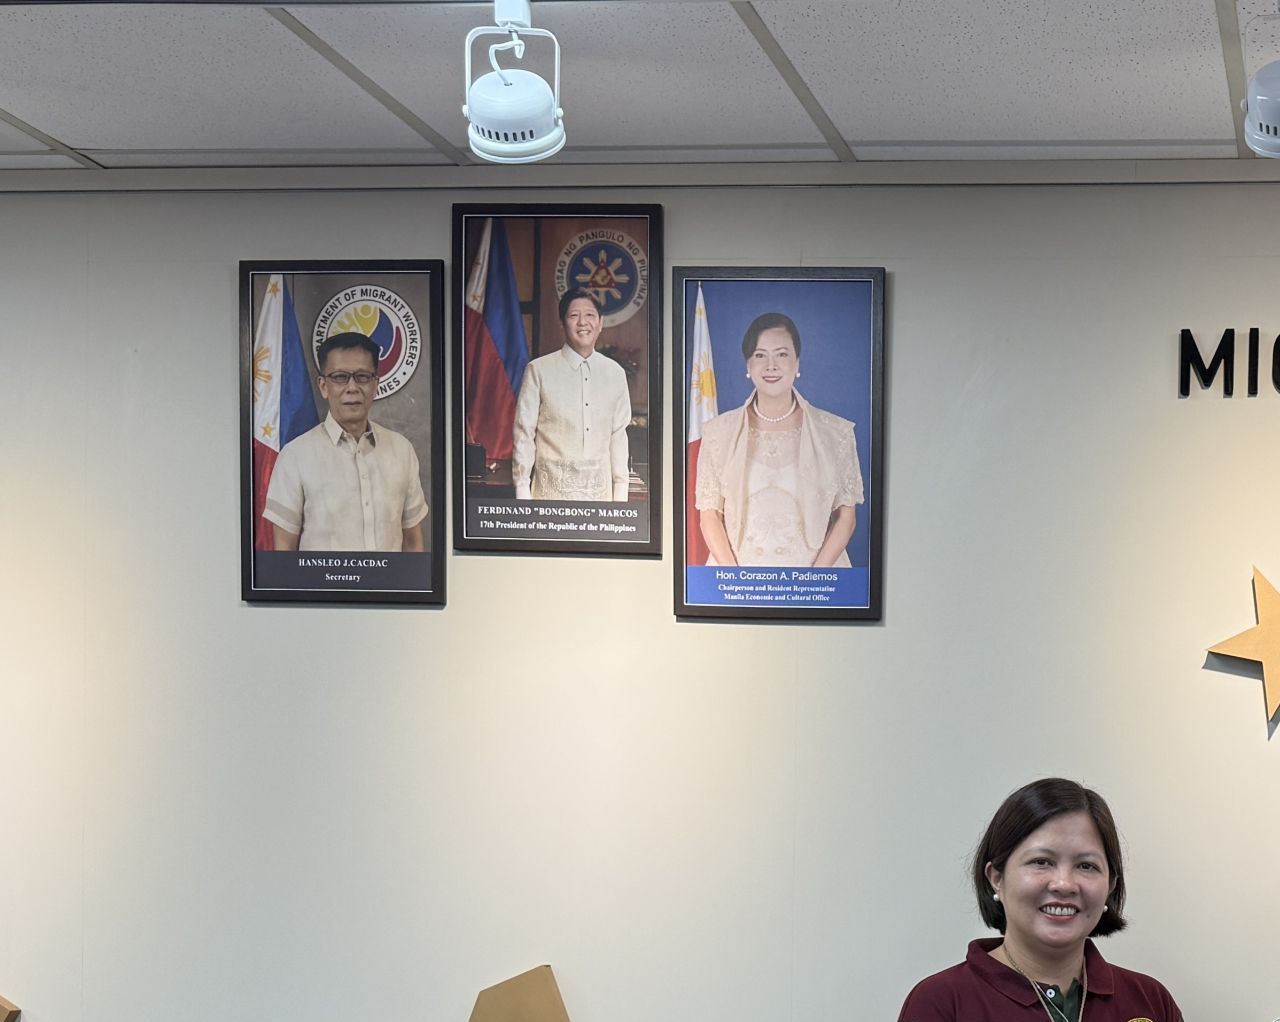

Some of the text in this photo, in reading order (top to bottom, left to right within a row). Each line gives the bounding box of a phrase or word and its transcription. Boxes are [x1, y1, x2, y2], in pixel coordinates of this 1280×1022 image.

[564, 243, 577, 257] NG
[579, 230, 624, 244] PANGULO
[626, 241, 640, 256] NG
[344, 289, 357, 302] OF
[360, 288, 406, 312] MIGRANT
[402, 311, 418, 367] WORKERS
[478, 506, 638, 518] FERDINAND "BONGBONG" MARCOS
[480, 520, 636, 533] 17th President of the Republic of the Philippines
[298, 558, 341, 567] HANSLEO
[325, 573, 361, 582] Secretary
[716, 571, 737, 580] Hon.
[739, 571, 778, 580] Corazon
[780, 571, 790, 580] A.
[718, 584, 754, 592] Chairperson
[767, 584, 792, 592] Resident
[746, 593, 774, 601] Economic
